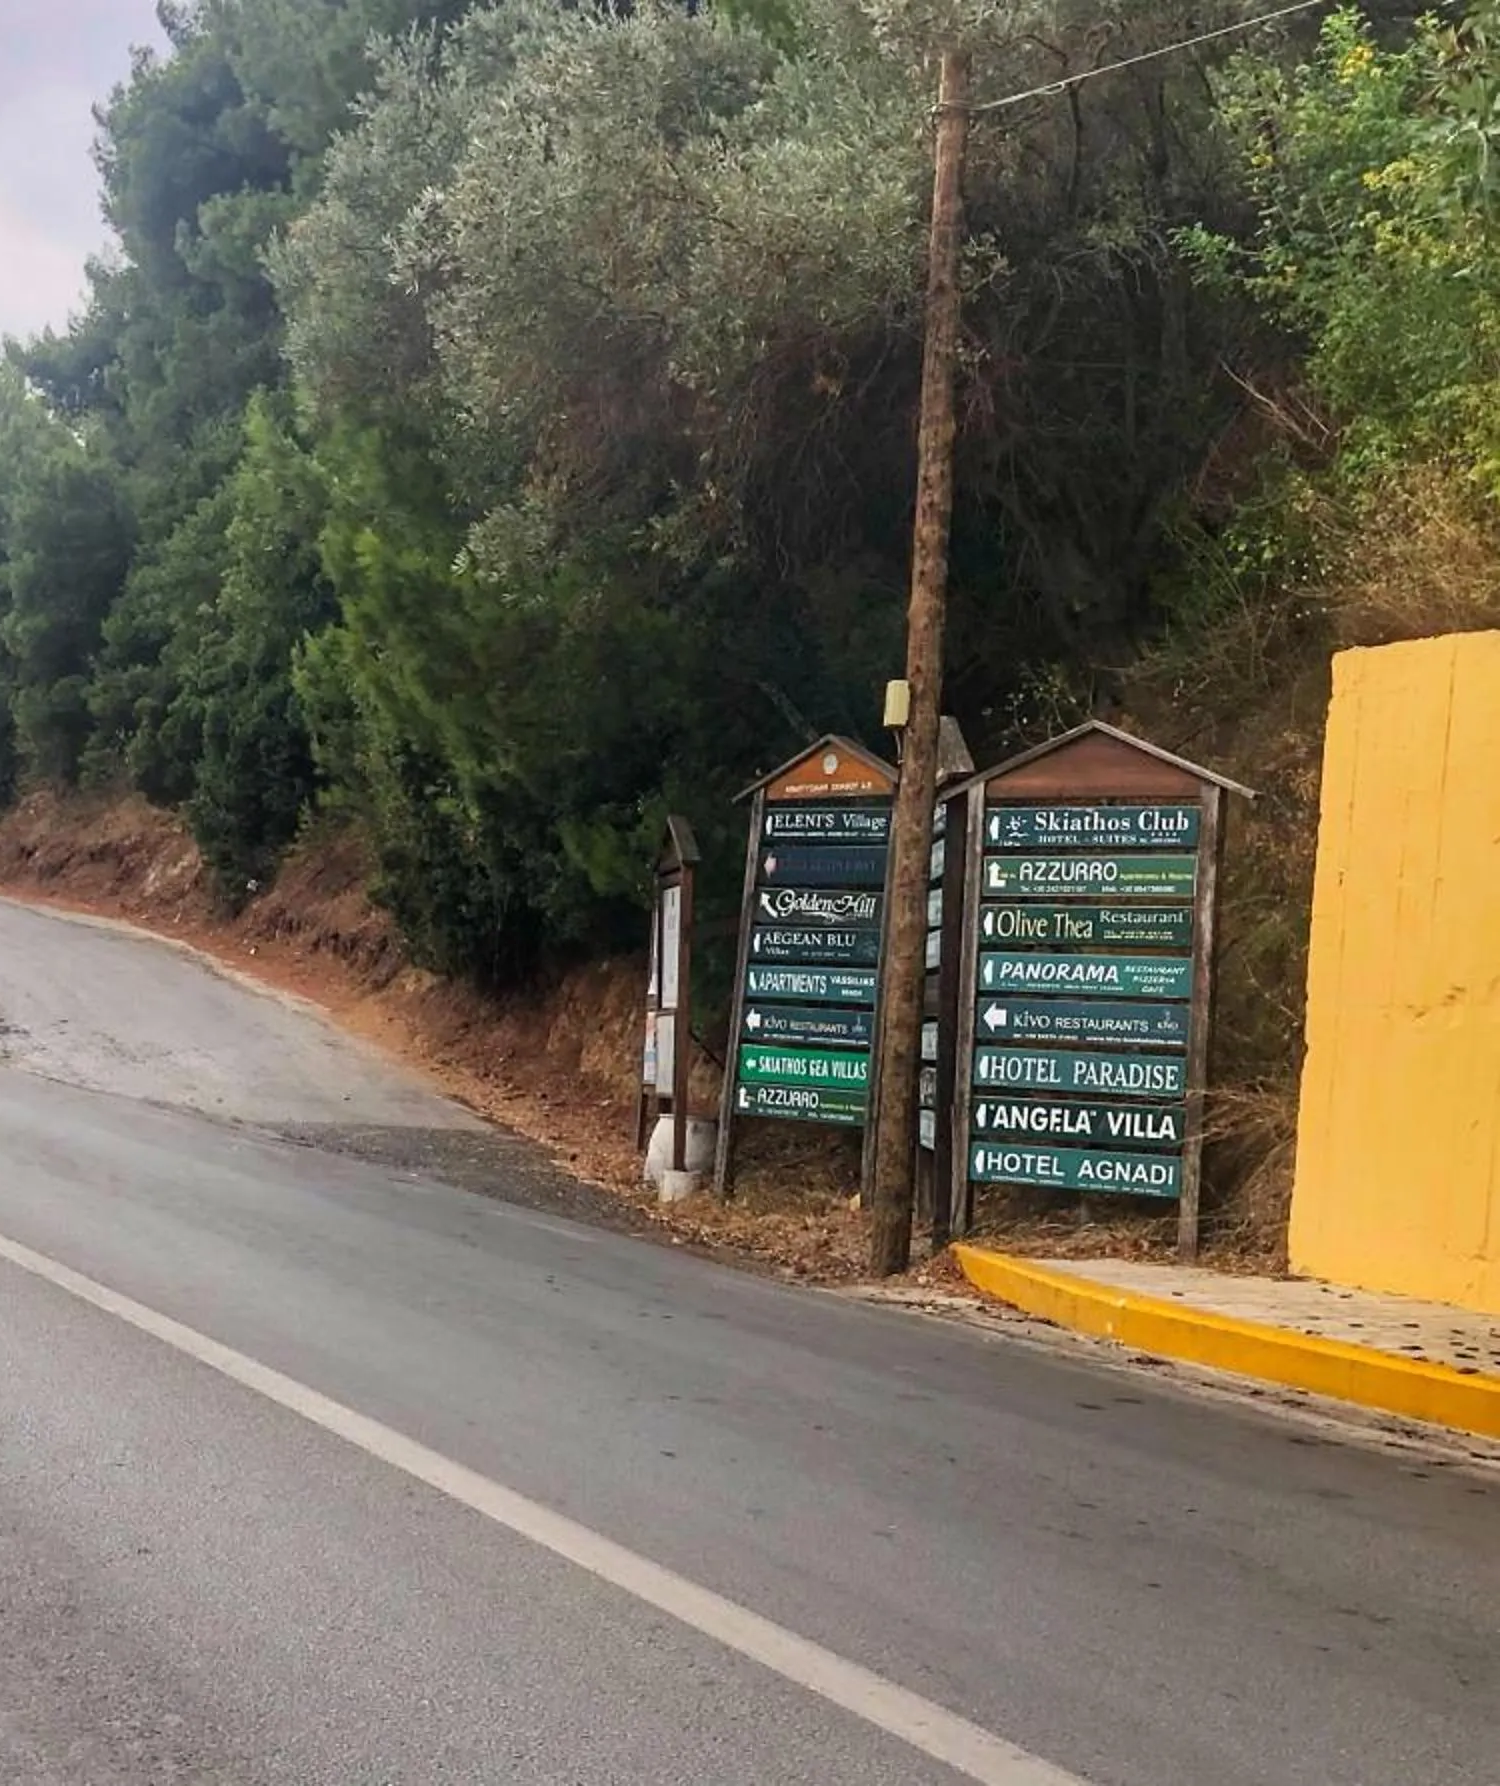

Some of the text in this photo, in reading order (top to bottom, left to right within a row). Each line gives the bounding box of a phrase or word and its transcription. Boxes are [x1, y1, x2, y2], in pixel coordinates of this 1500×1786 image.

[842, 813, 887, 831] Village
[1034, 810, 1189, 832] Skiathos Club
[1038, 835, 1081, 844] HOTEL
[1092, 835, 1137, 844] SUITES
[1019, 861, 1118, 882] AZZURRO
[775, 889, 877, 919] Golden Hill
[997, 910, 1184, 939] Olive Thea Restaurant
[763, 931, 857, 947] AEGEAN BLU
[999, 961, 1119, 983] PANORAMA
[1124, 965, 1186, 976] RESTAURANT
[1132, 975, 1176, 985] PIZZERIA
[758, 971, 828, 994] APARTMENTS
[789, 1021, 848, 1034] RESTAURANTS
[1055, 1017, 1150, 1032] RESTAURANTS
[758, 1055, 868, 1081] SKIATHOS GEA VILLAS
[990, 1055, 1180, 1091] HOTEL PARADISE
[757, 1087, 819, 1109] AZZURRO
[1106, 1110, 1177, 1141] VILLA
[986, 1151, 1175, 1186] HOTEL AGNADI
